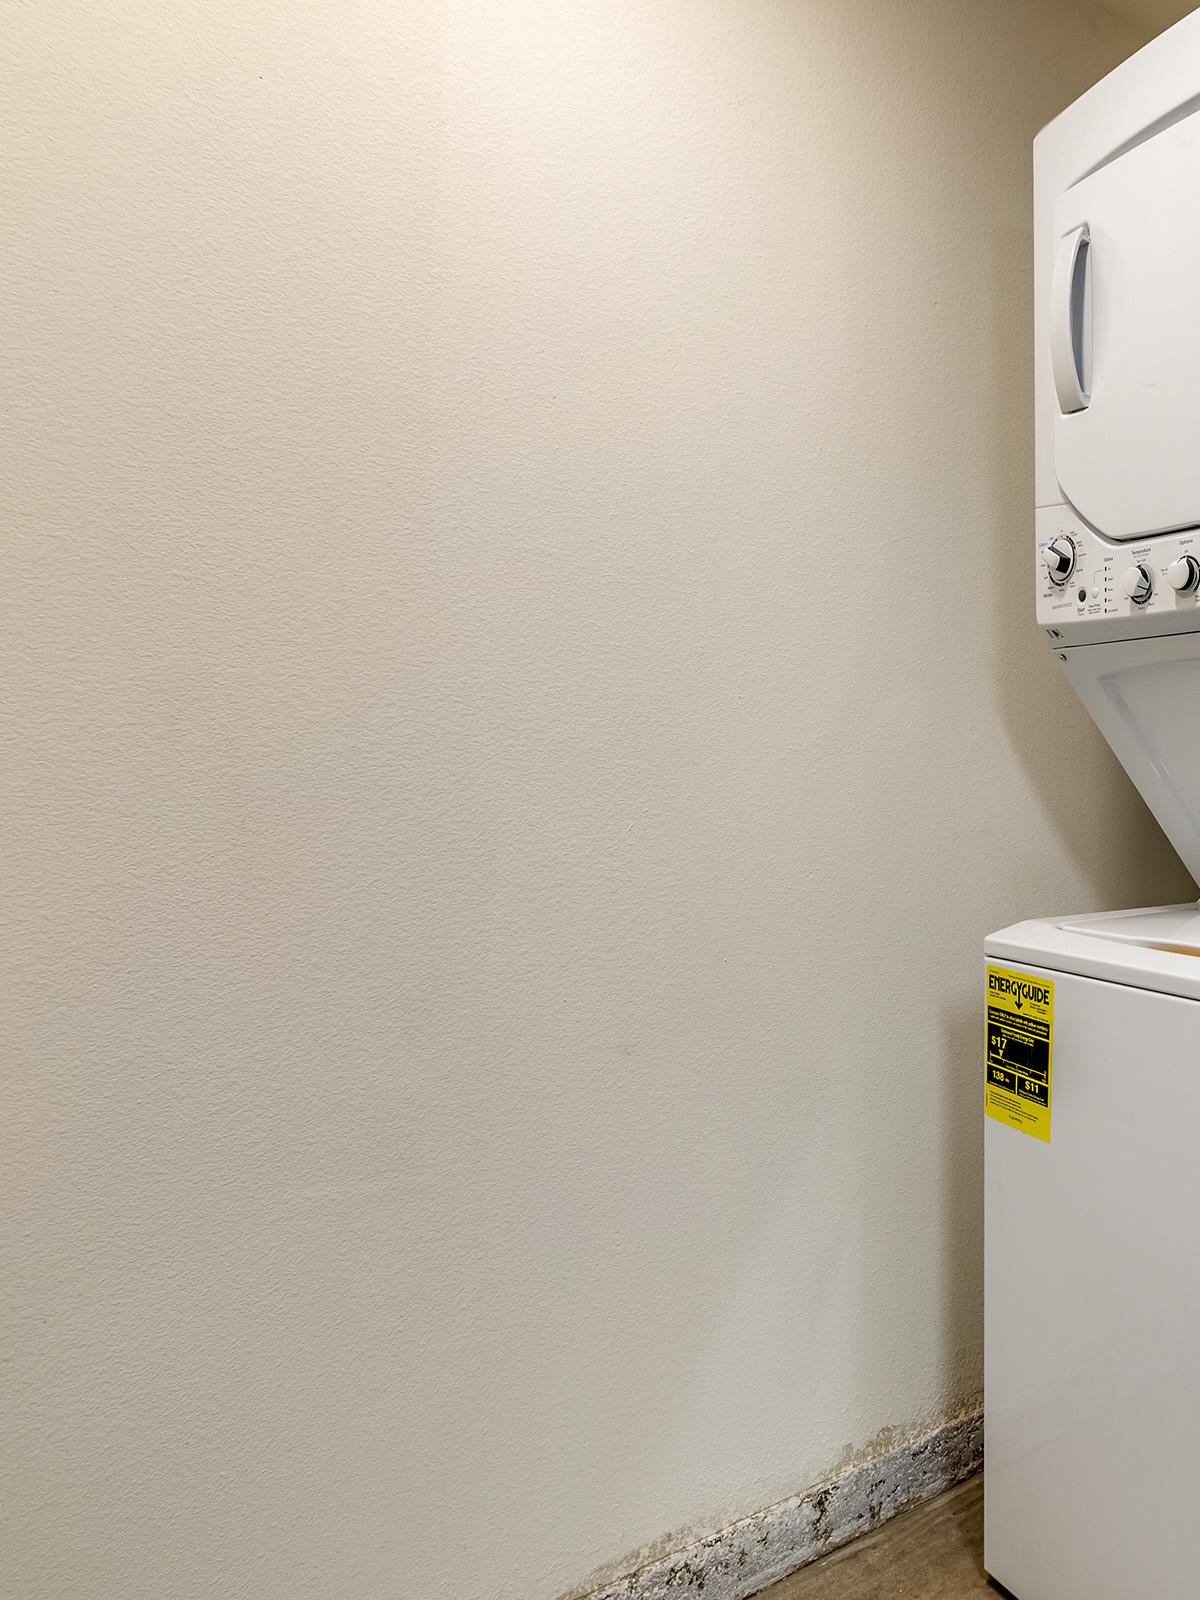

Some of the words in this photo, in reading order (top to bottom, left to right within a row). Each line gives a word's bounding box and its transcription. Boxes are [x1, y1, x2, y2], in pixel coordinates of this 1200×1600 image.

[989, 974, 1049, 1006] ENERGYGUIDE
[991, 1036, 1007, 1049] $17
[1025, 1081, 1038, 1093] $11
